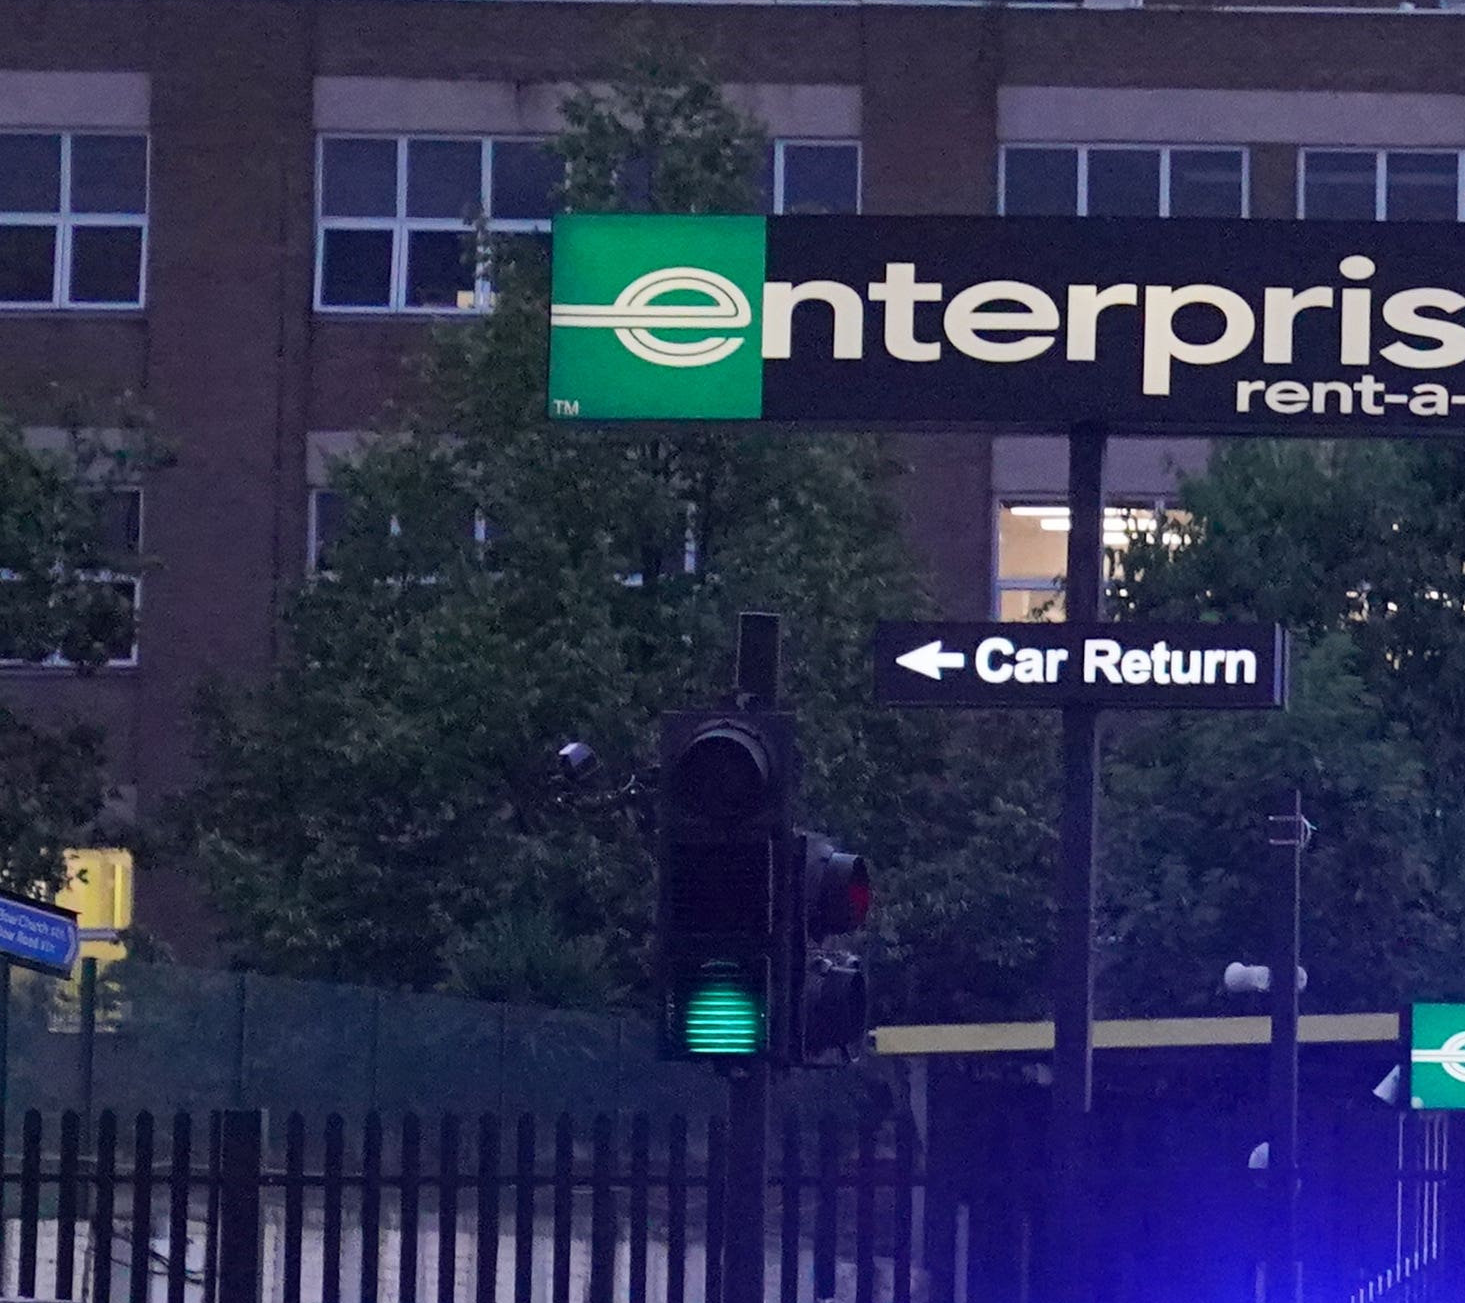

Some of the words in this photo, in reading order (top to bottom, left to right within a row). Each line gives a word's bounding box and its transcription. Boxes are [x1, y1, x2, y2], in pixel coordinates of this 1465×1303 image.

[554, 400, 580, 415] TM
[975, 637, 1068, 684] Car
[1084, 638, 1256, 685] Return
